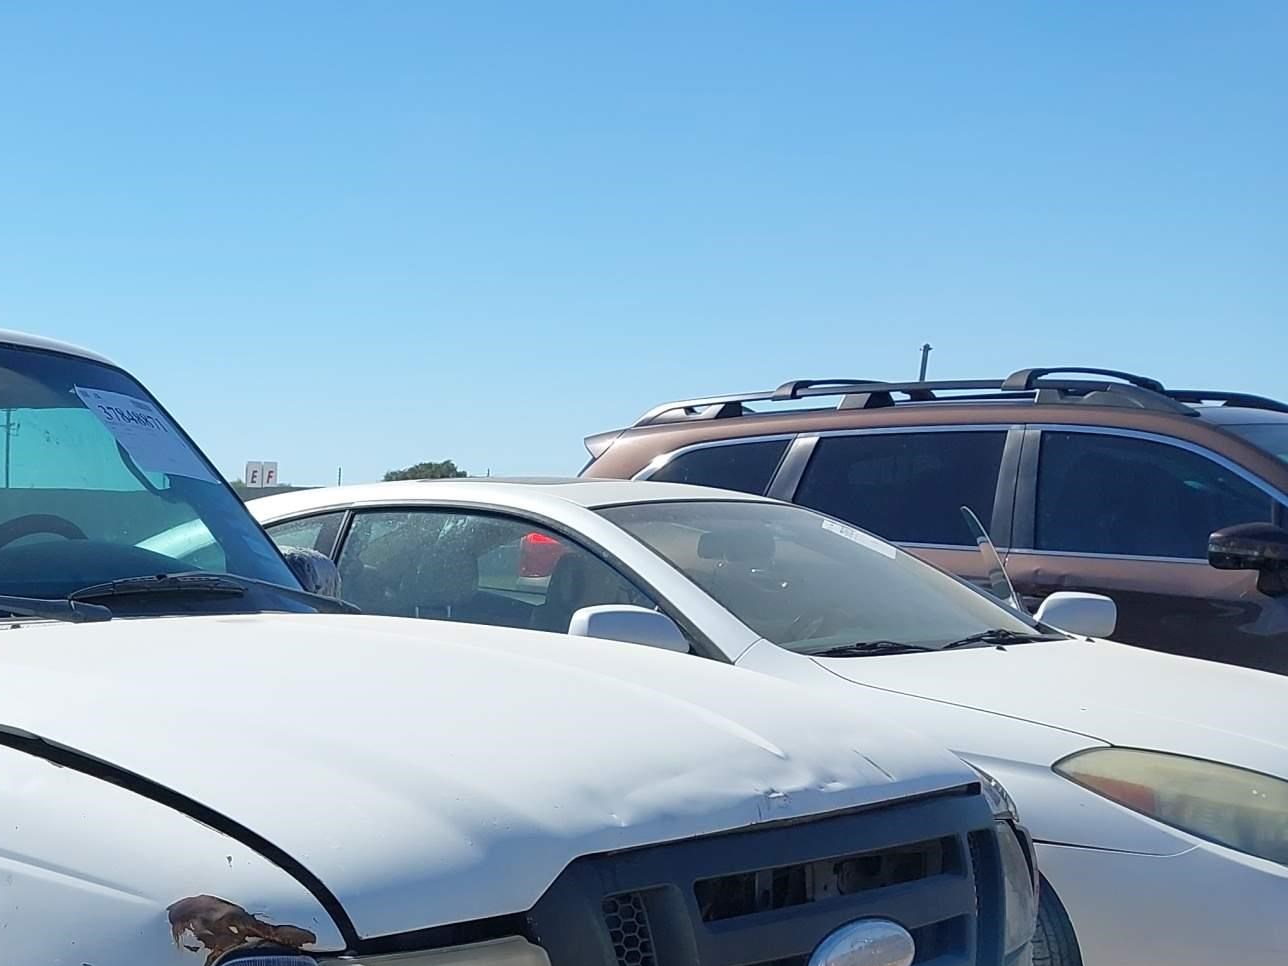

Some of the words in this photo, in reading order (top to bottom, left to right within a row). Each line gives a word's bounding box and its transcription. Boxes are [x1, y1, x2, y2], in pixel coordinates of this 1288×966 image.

[97, 405, 168, 432] 37848871
[250, 470, 258, 484] E
[266, 470, 274, 484] F
